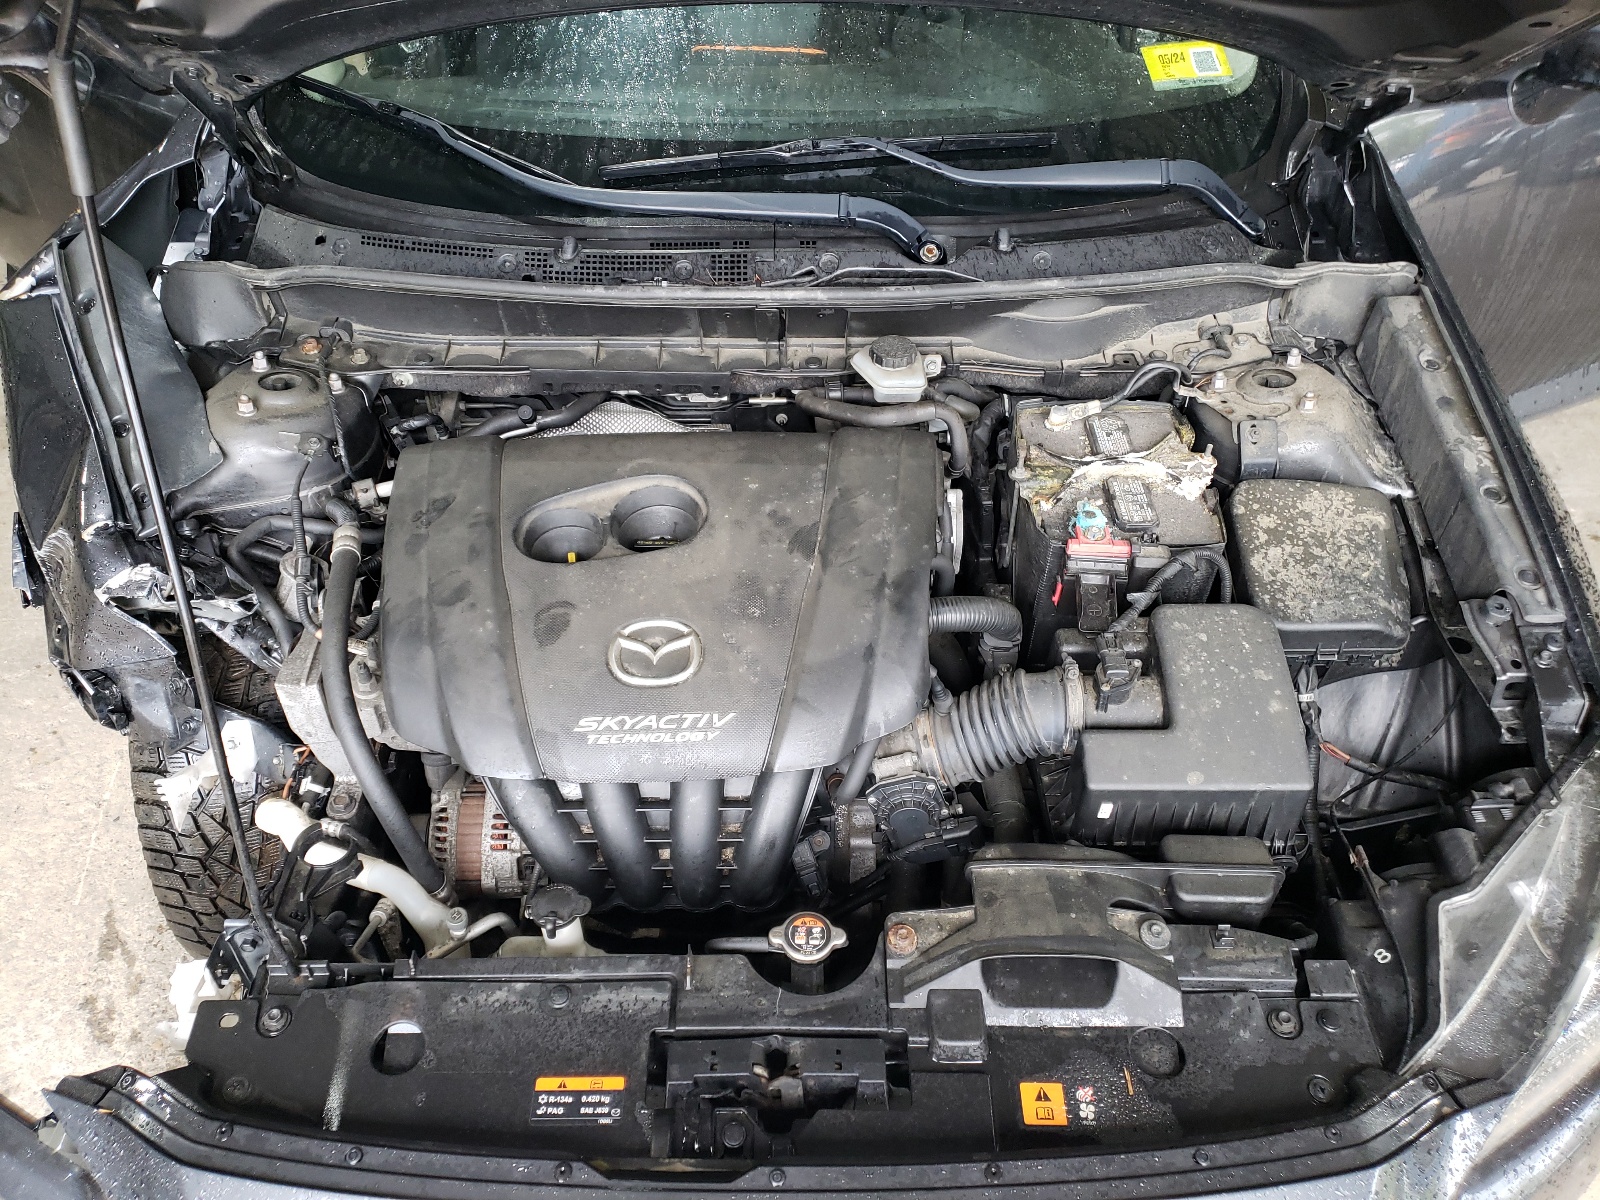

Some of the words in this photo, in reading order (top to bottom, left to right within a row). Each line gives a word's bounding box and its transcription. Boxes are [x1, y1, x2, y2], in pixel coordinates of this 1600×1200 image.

[1158, 52, 1186, 65] 05/24
[573, 712, 737, 732] SKYACTIV
[586, 730, 722, 745] TECHNOLOGY
[600, 1095, 610, 1104] kg
[546, 1107, 564, 1115] PAG
